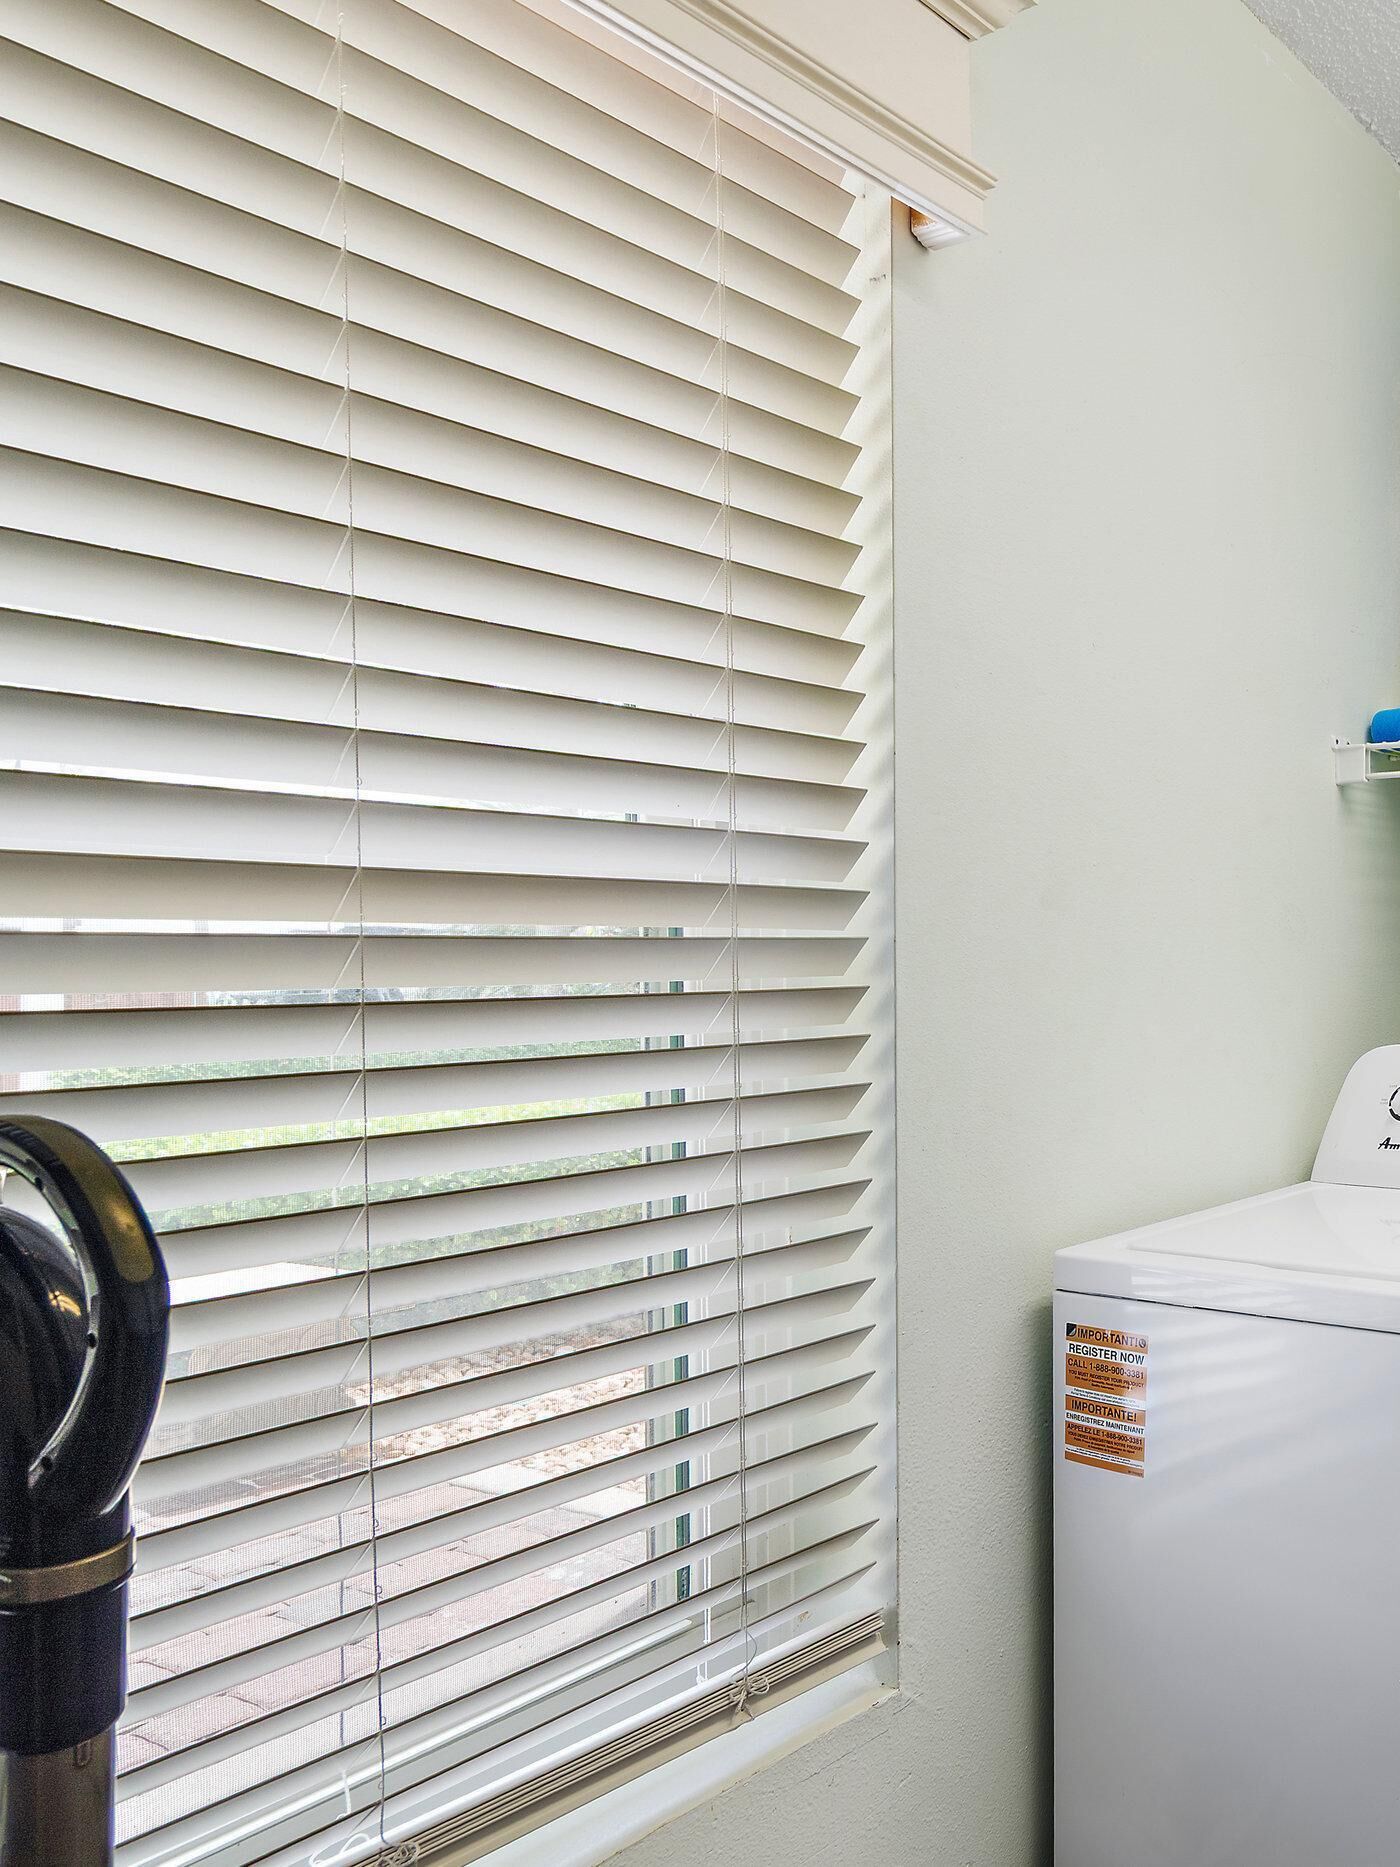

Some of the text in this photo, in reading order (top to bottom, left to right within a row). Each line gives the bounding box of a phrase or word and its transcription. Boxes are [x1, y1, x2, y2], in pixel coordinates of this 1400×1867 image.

[1077, 1328, 1138, 1347] IMPORTANT!
[1068, 1343, 1144, 1365] REGISTER NOW
[1067, 1358, 1144, 1380] CALL 1-888-900-3381
[1071, 1399, 1137, 1422] IMPORTANTE!
[1066, 1412, 1144, 1435] ENREGISTREZ MAINTENANT
[1067, 1423, 1093, 1434] APPELEZ
[1093, 1428, 1101, 1436] LE
